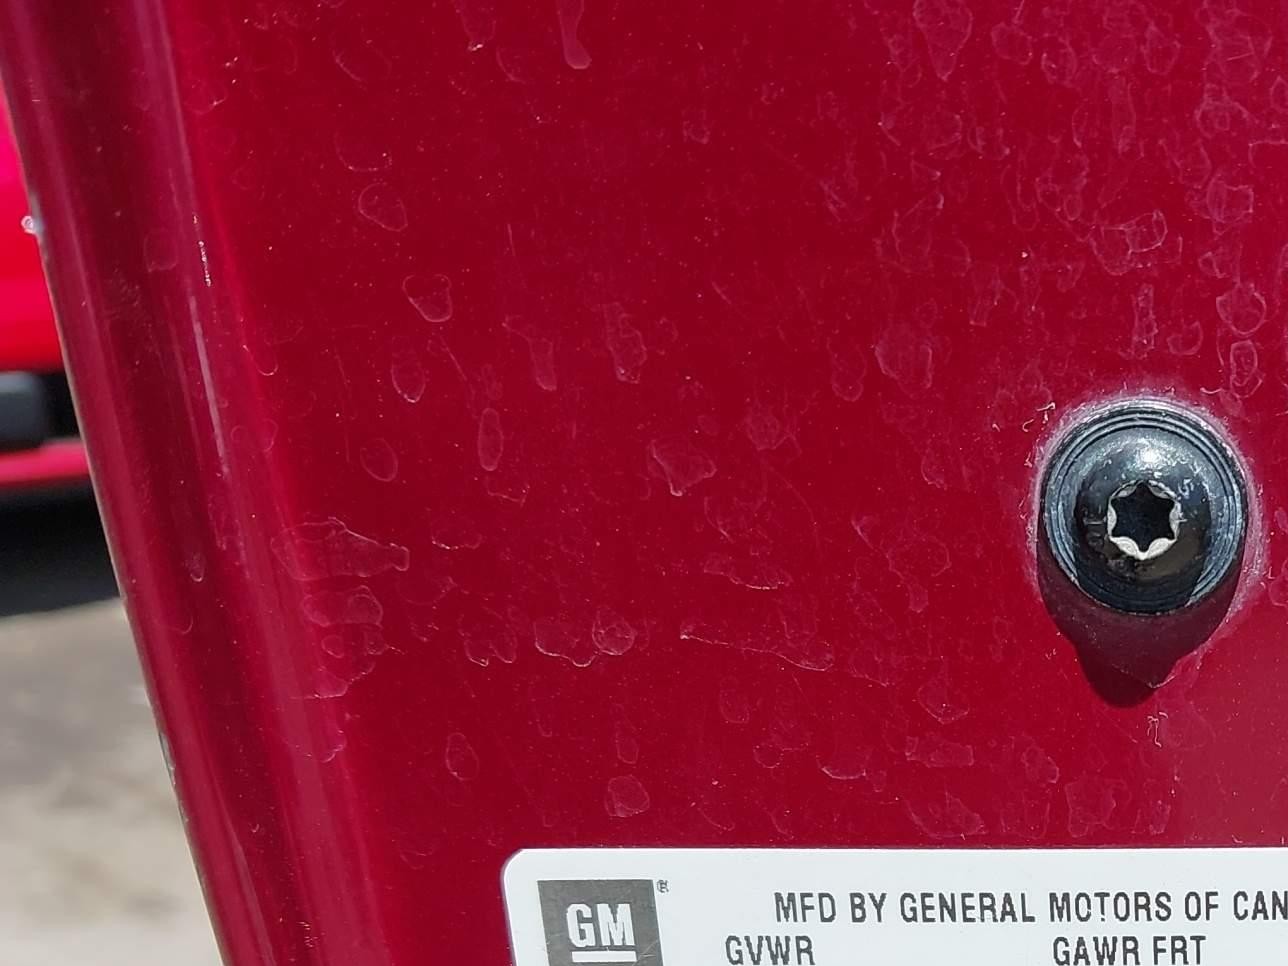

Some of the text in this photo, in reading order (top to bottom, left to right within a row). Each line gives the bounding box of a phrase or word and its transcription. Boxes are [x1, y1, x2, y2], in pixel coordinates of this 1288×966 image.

[774, 892, 836, 922] MFD
[850, 893, 886, 922] BY
[900, 893, 1035, 922] GENERAL
[1049, 892, 1171, 922] MOTORS
[1185, 891, 1218, 921] OF
[567, 903, 635, 947] GM
[725, 936, 815, 965] GVWR
[1053, 936, 1206, 966] GAWR FRT
